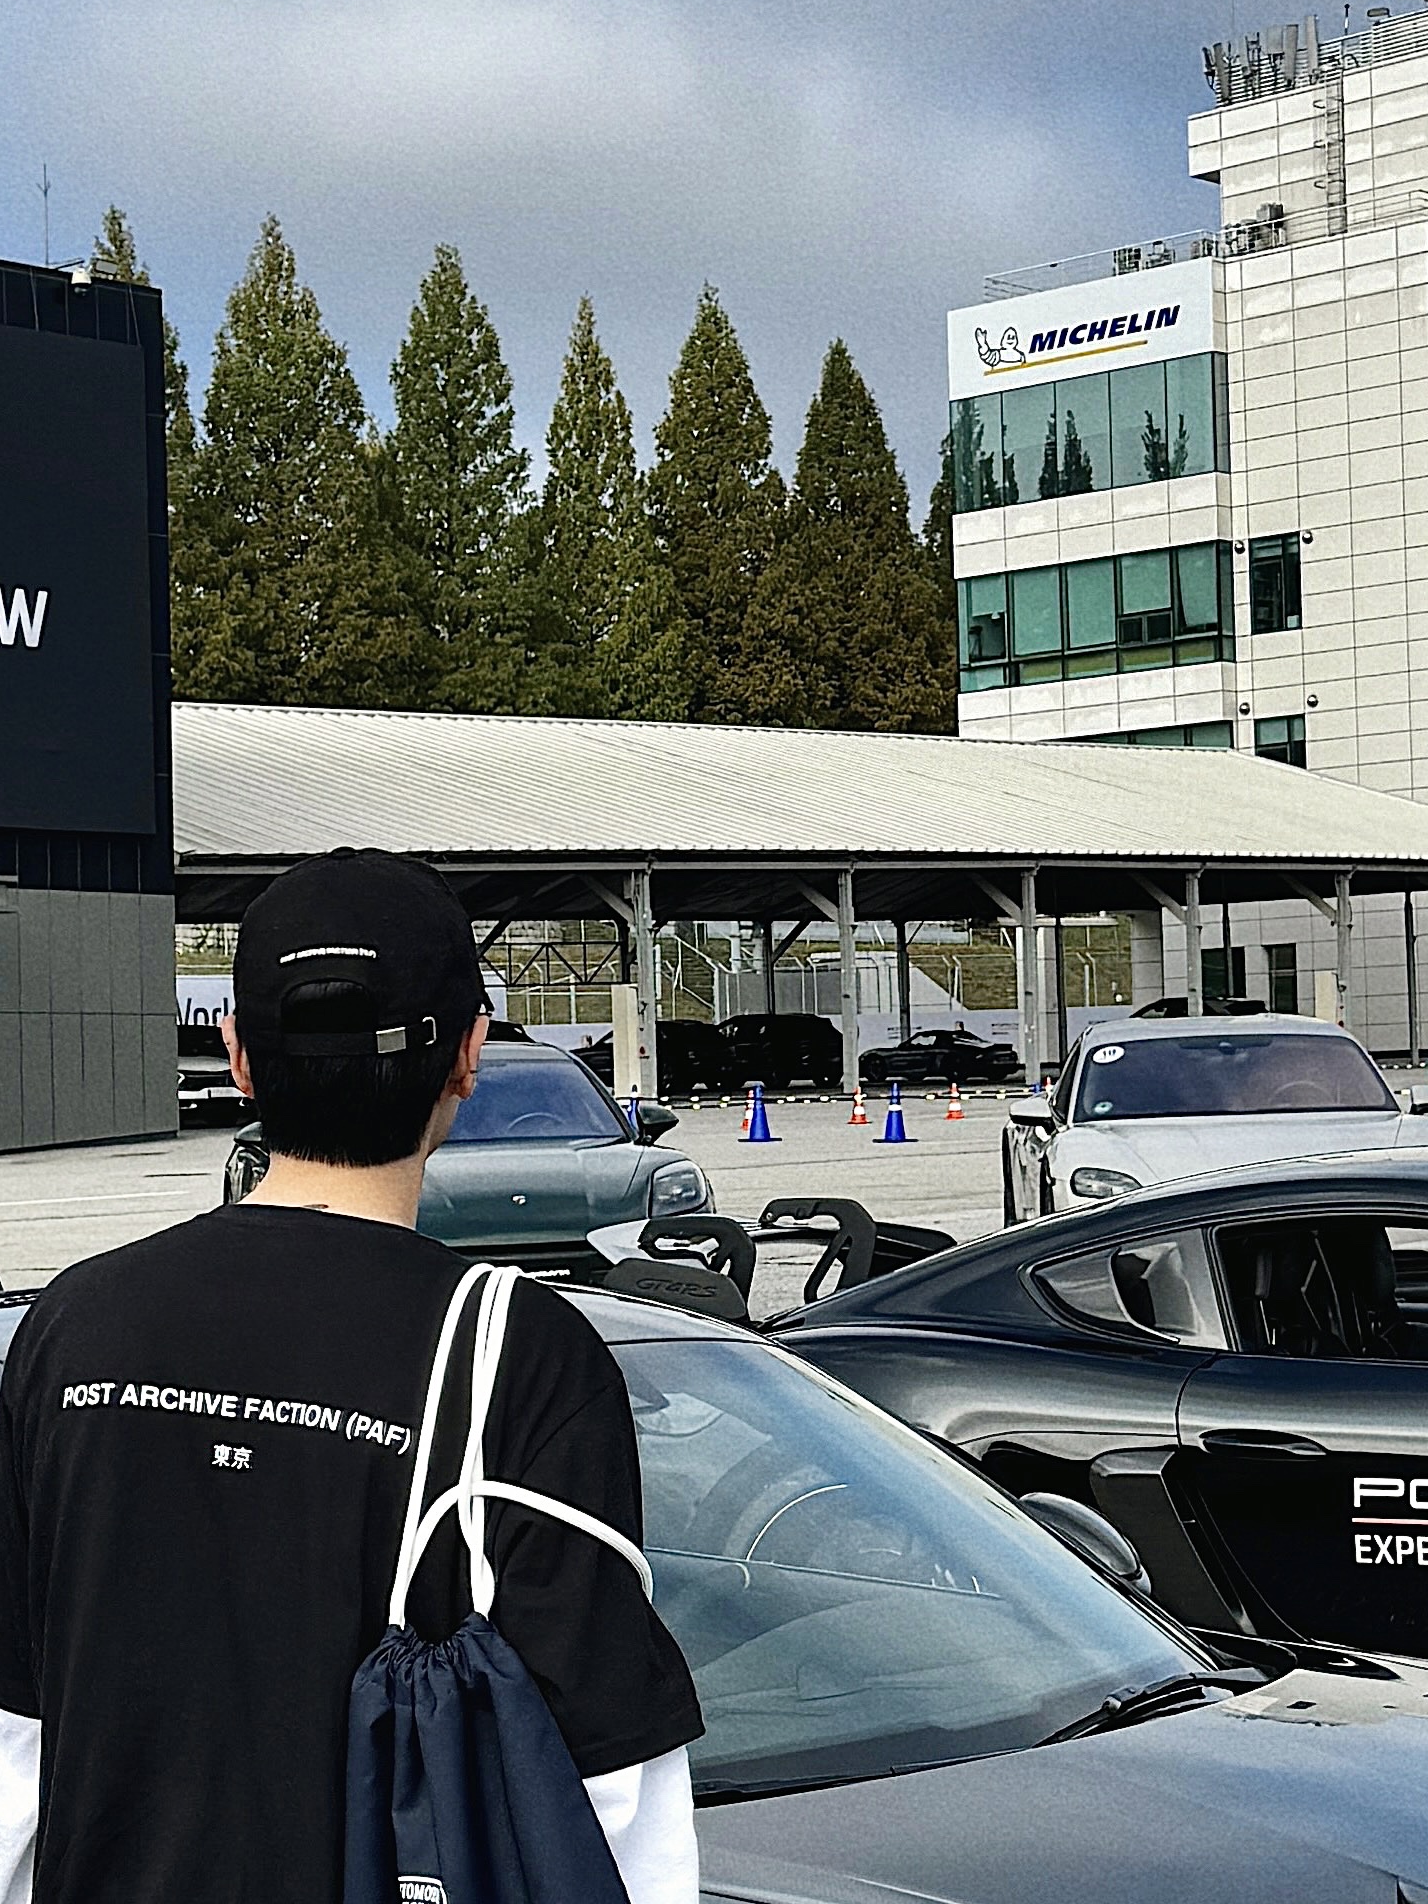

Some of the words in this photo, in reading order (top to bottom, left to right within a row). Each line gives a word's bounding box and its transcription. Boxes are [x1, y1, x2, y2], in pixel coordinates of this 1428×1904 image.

[1029, 304, 1181, 354] MICHELIN
[63, 1382, 116, 1409] POST
[120, 1384, 239, 1418] ARCHIVE
[244, 1398, 342, 1432] FACTION
[345, 1412, 413, 1456] (PAF)
[211, 1443, 253, 1470] 東京
